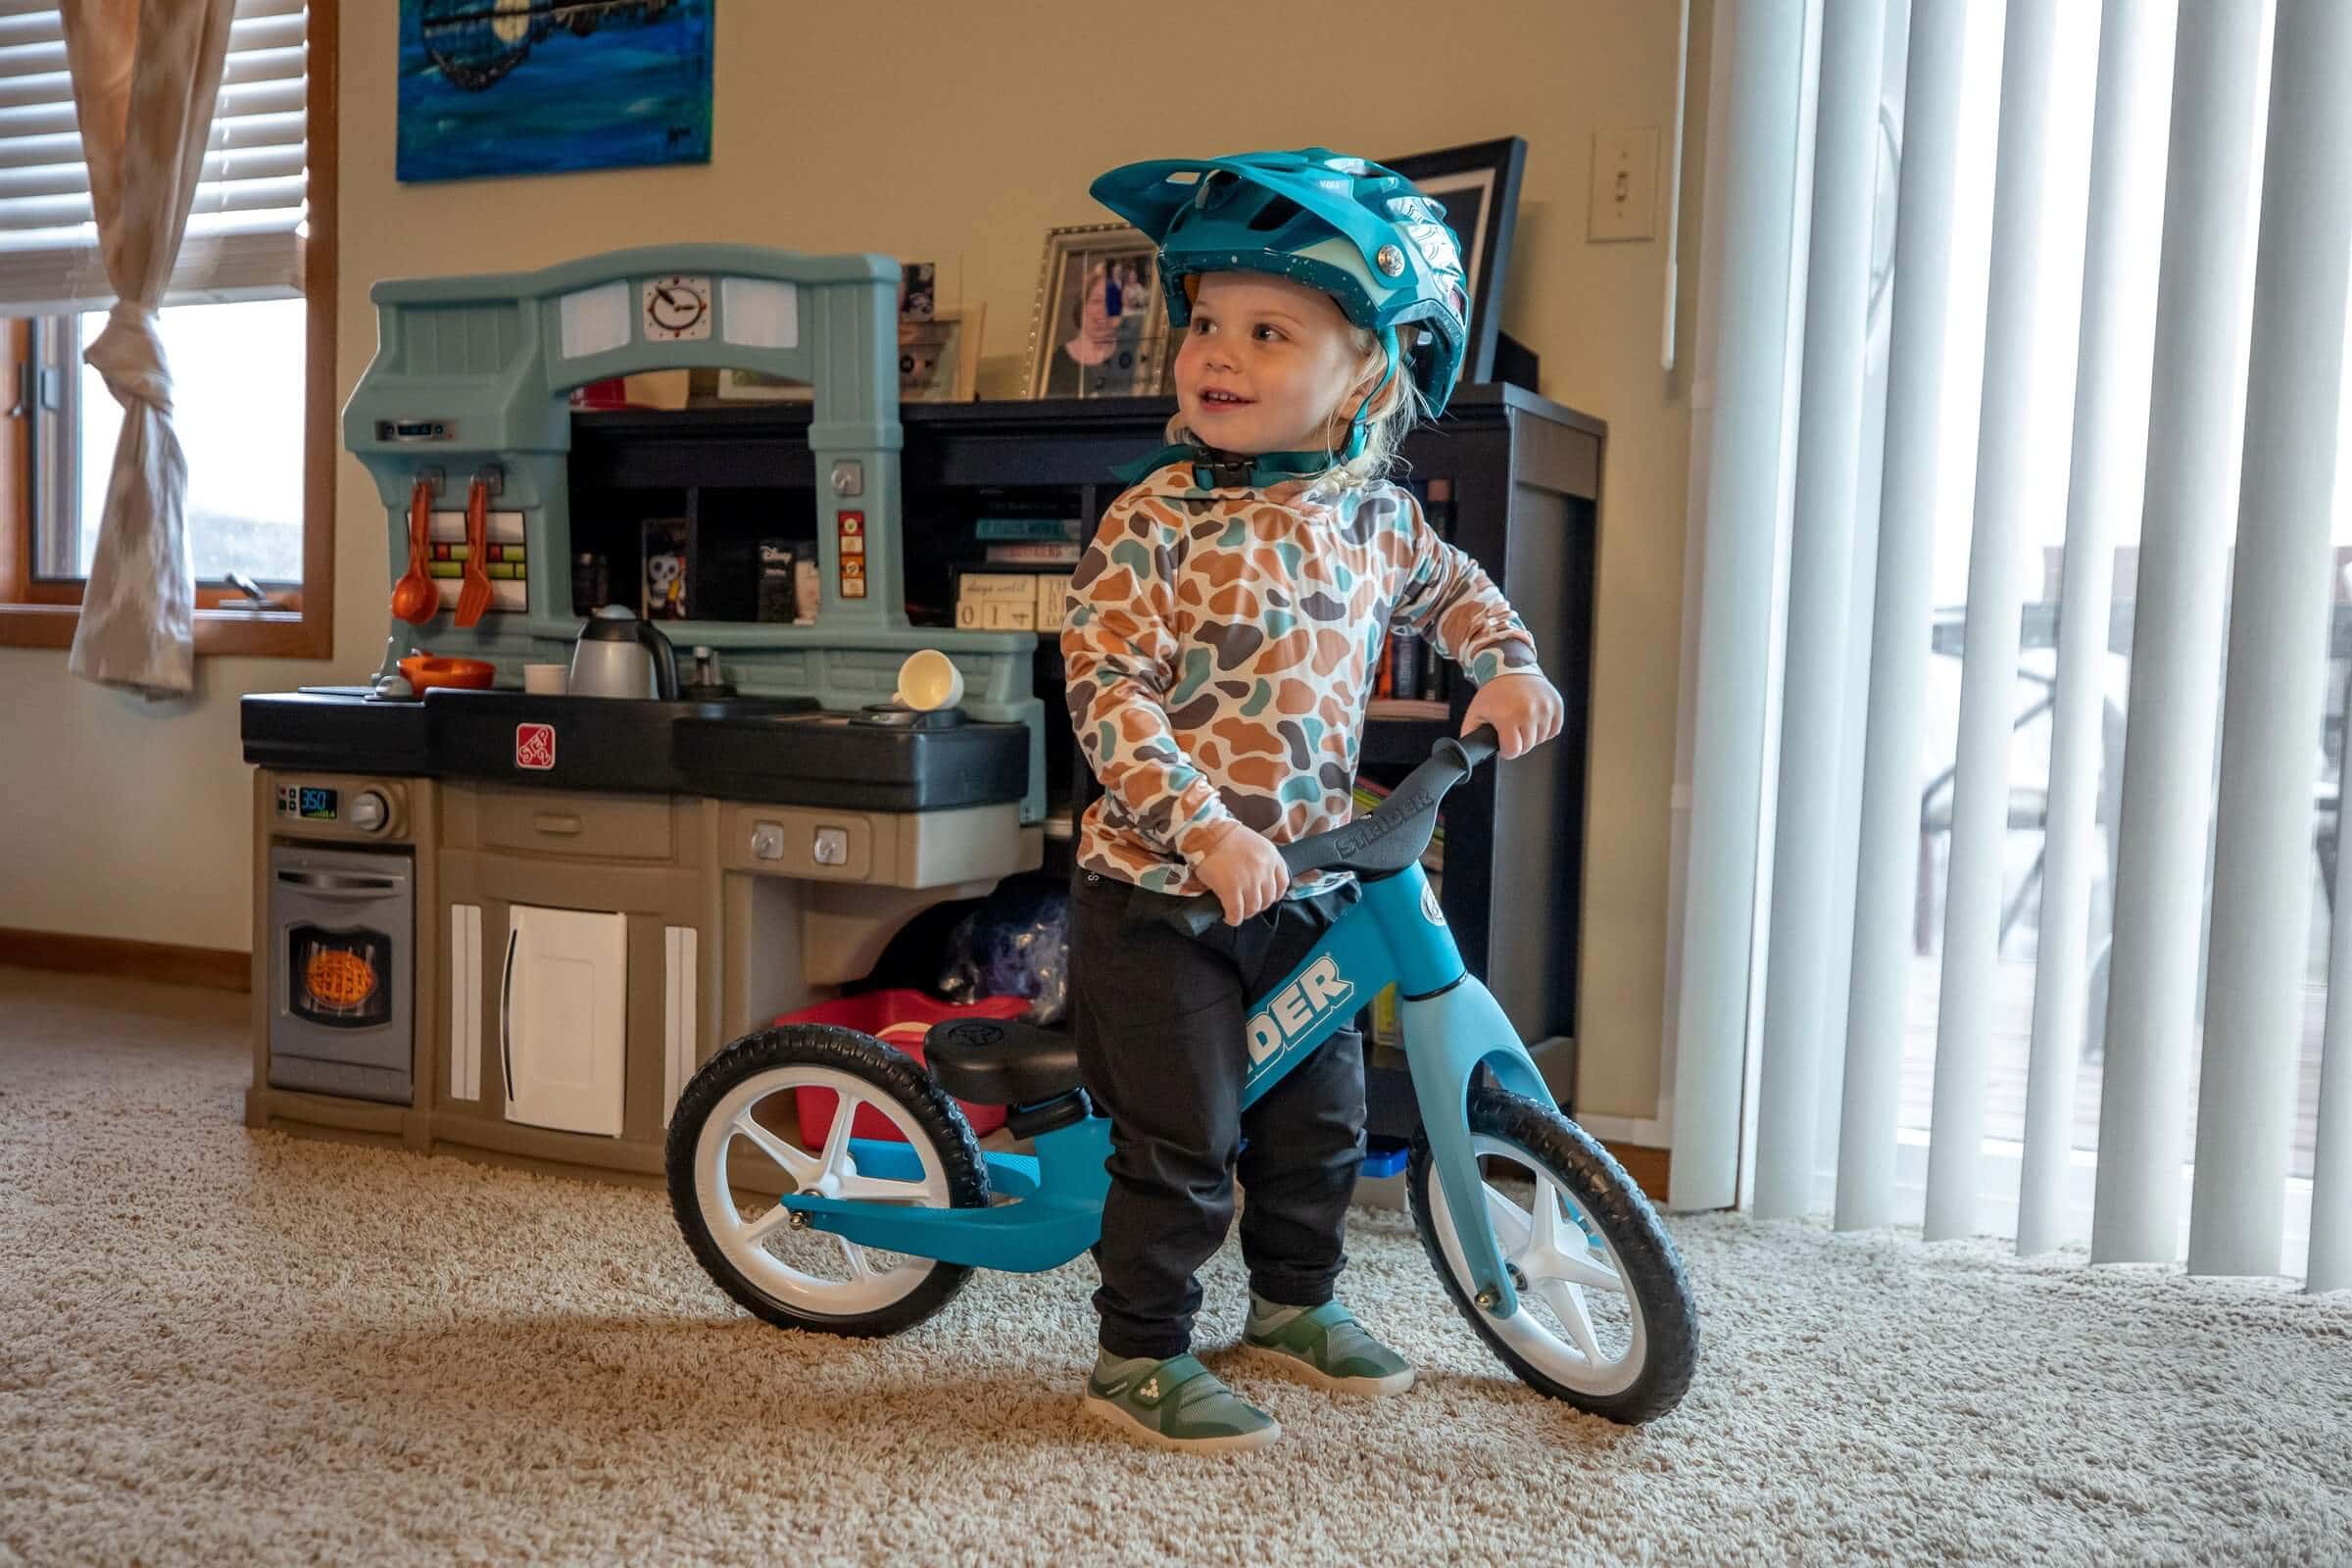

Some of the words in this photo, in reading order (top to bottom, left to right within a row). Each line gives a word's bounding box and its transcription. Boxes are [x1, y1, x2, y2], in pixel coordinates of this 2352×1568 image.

[519, 727, 549, 763] STEP
[537, 747, 551, 765] 2
[301, 789, 326, 809] 350
[1246, 956, 1354, 1076] DER
